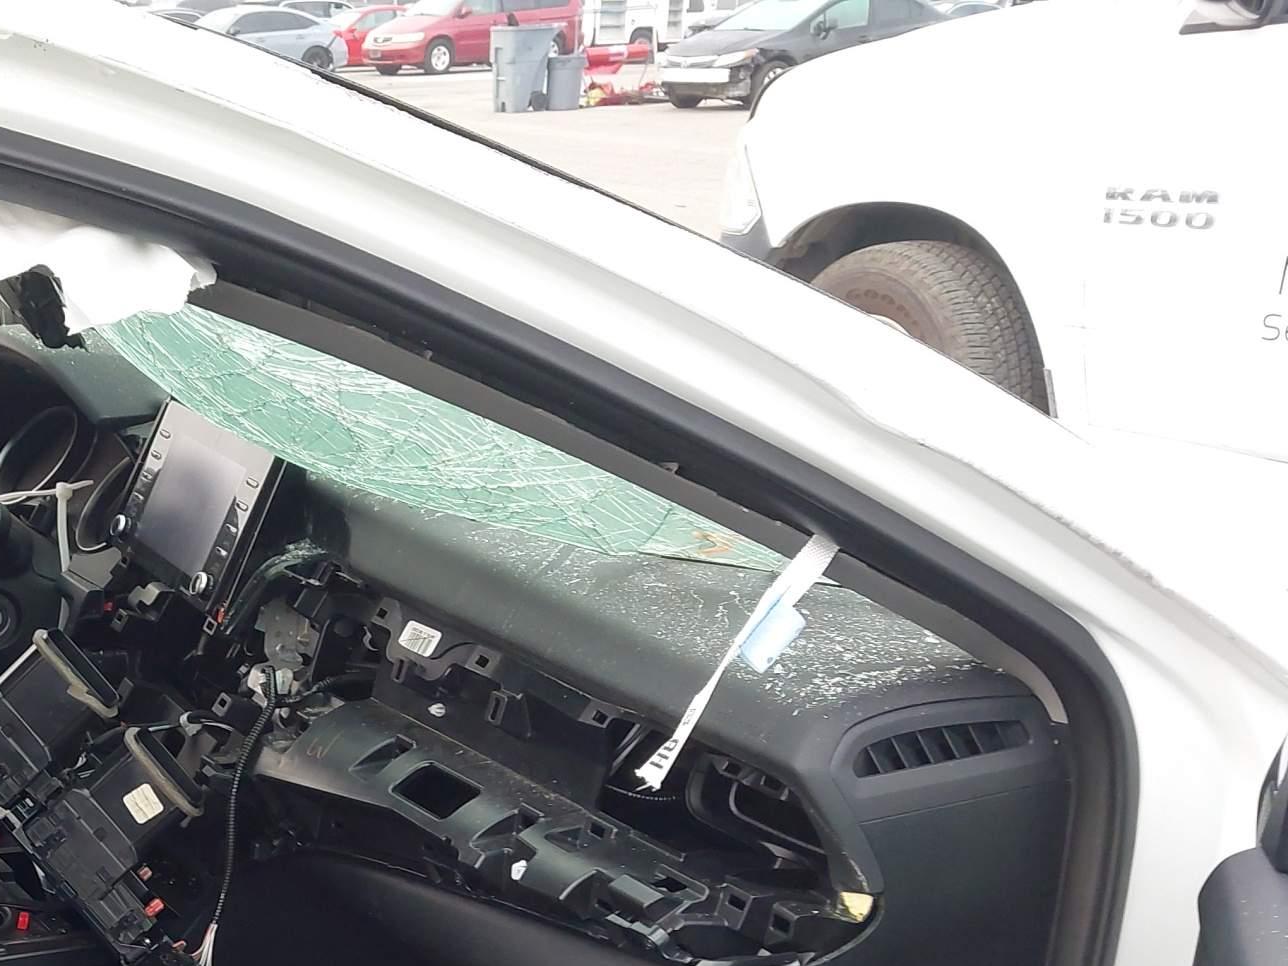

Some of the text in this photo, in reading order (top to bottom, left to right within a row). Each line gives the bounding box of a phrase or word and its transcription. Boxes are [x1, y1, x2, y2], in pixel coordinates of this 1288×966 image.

[1105, 187, 1219, 204] RAM
[1103, 207, 1215, 230] 1500
[1261, 313, 1288, 341] S
